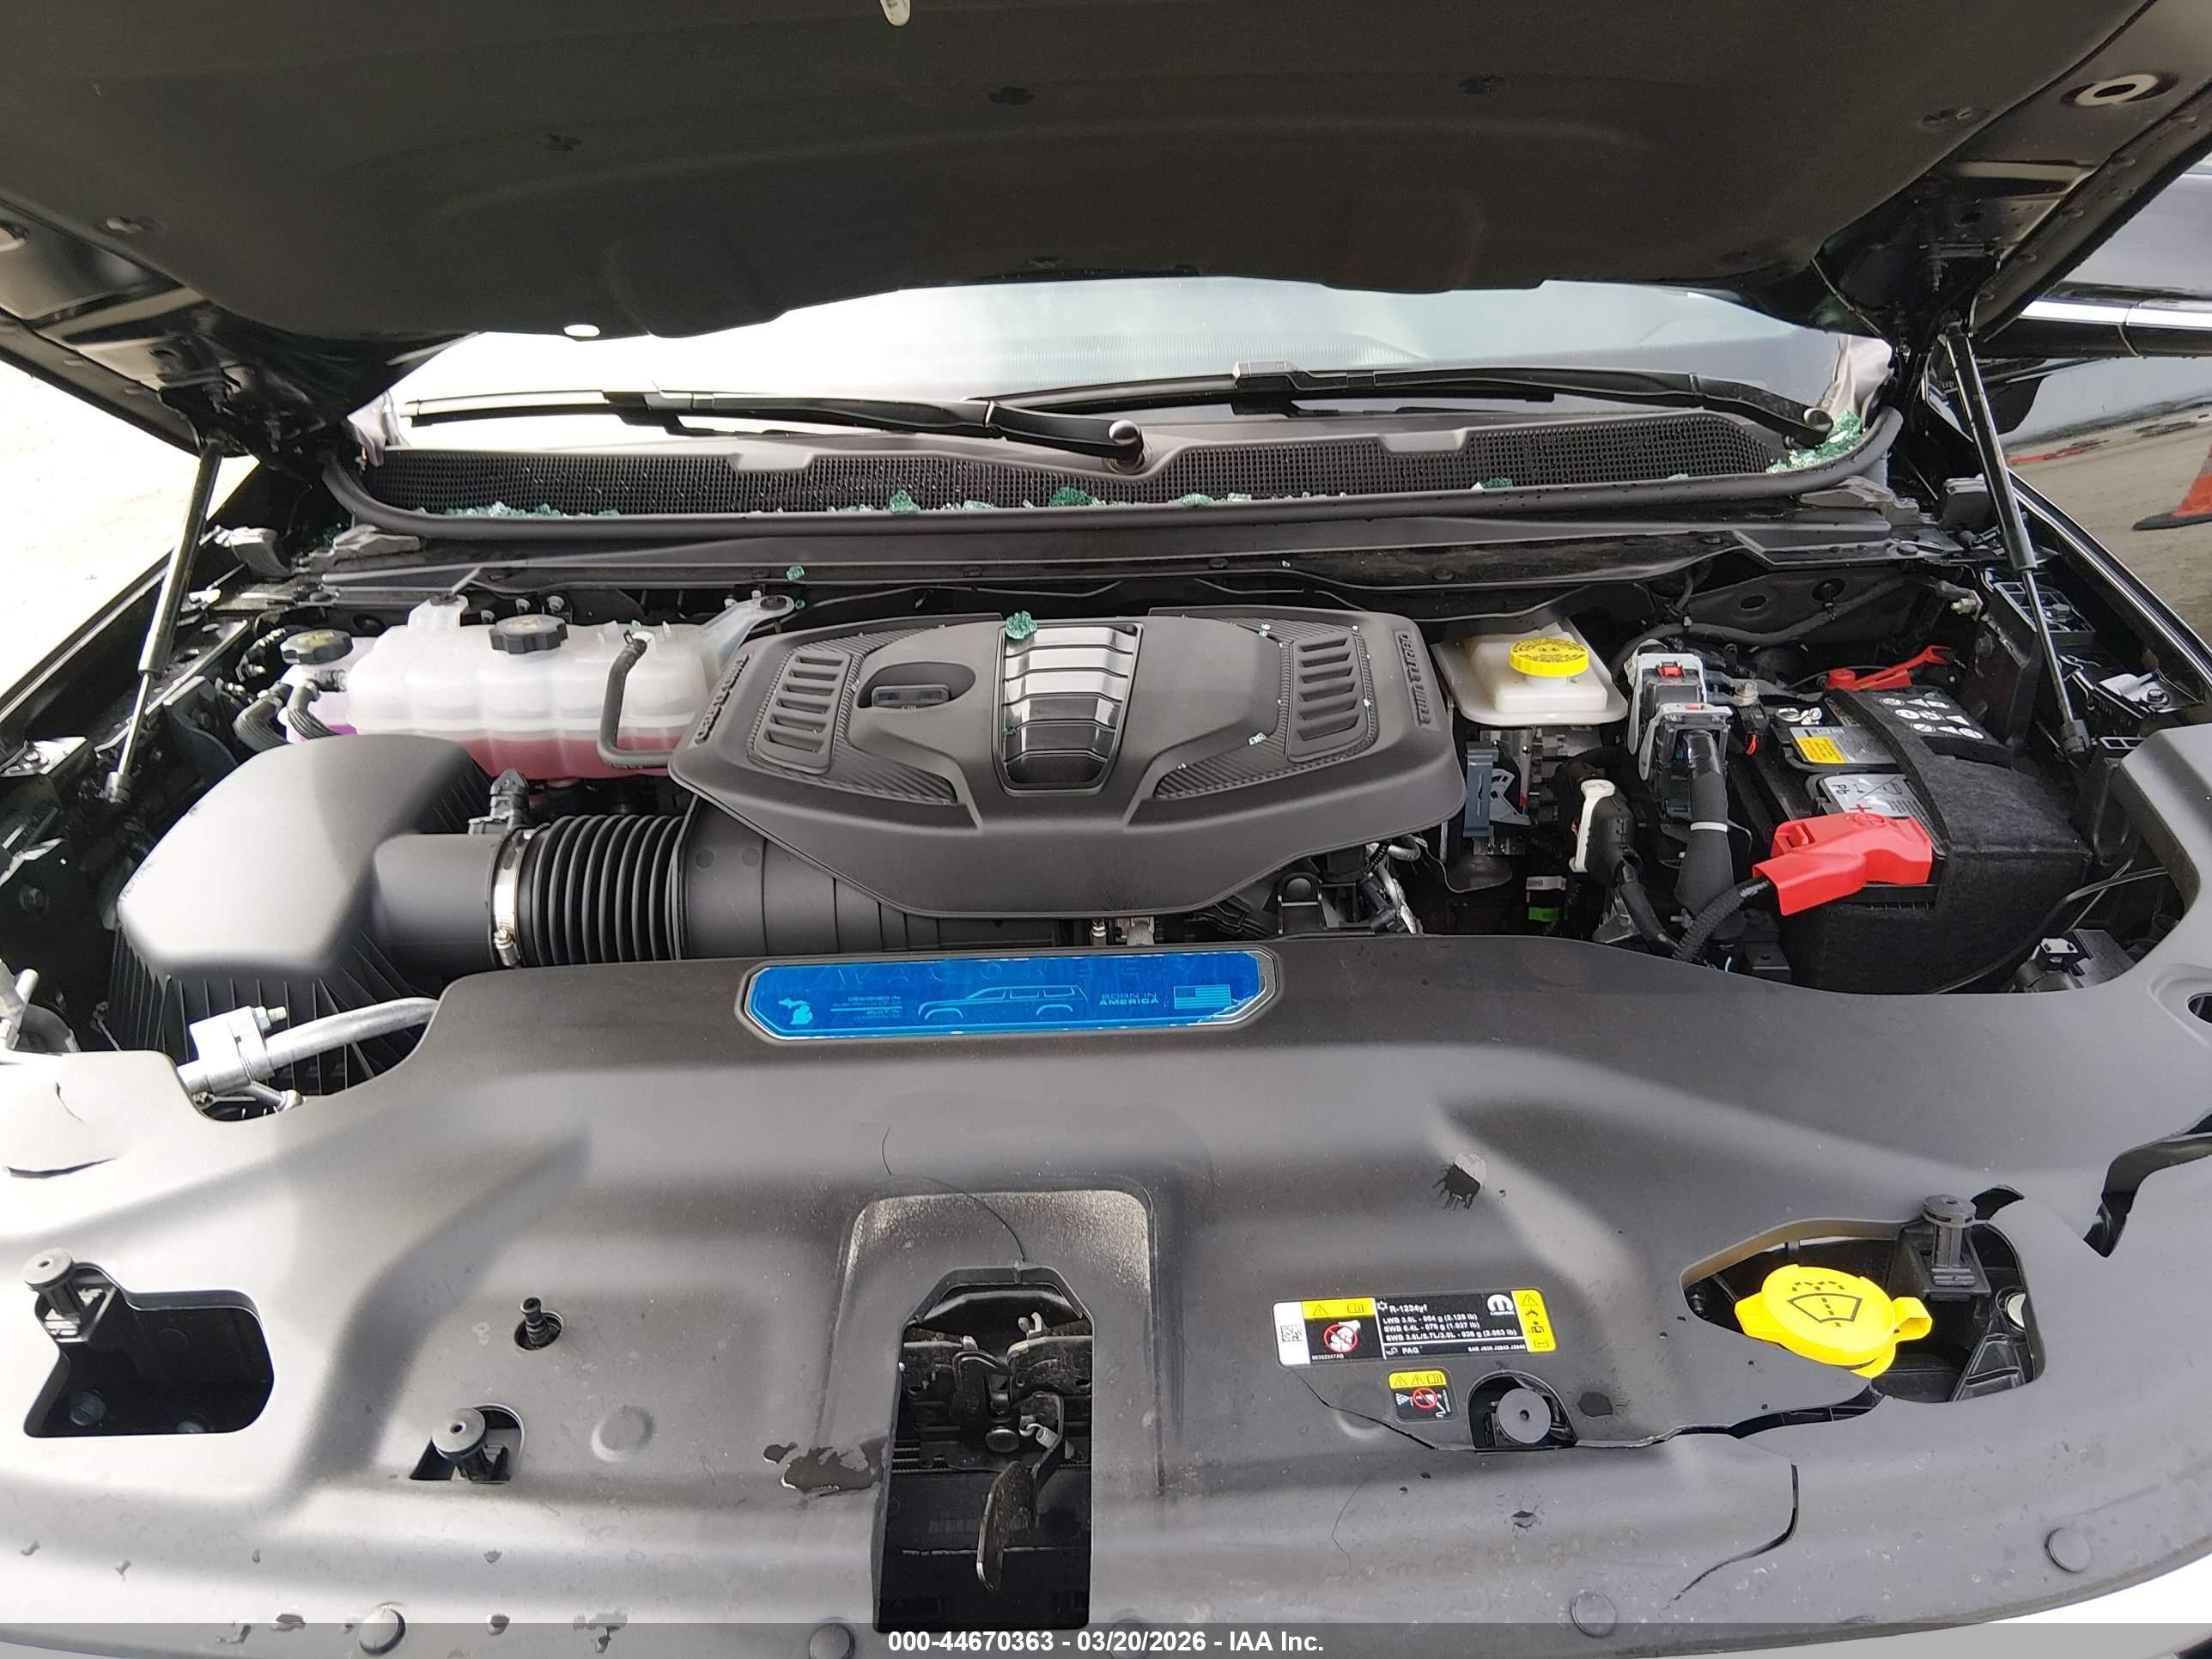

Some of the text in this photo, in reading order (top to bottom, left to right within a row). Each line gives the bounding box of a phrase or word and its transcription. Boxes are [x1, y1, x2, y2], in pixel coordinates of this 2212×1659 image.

[1398, 633, 1421, 683] TURBO
[1099, 997, 1159, 1006] AMERICA
[1389, 1304, 1427, 1314] R-1234yf
